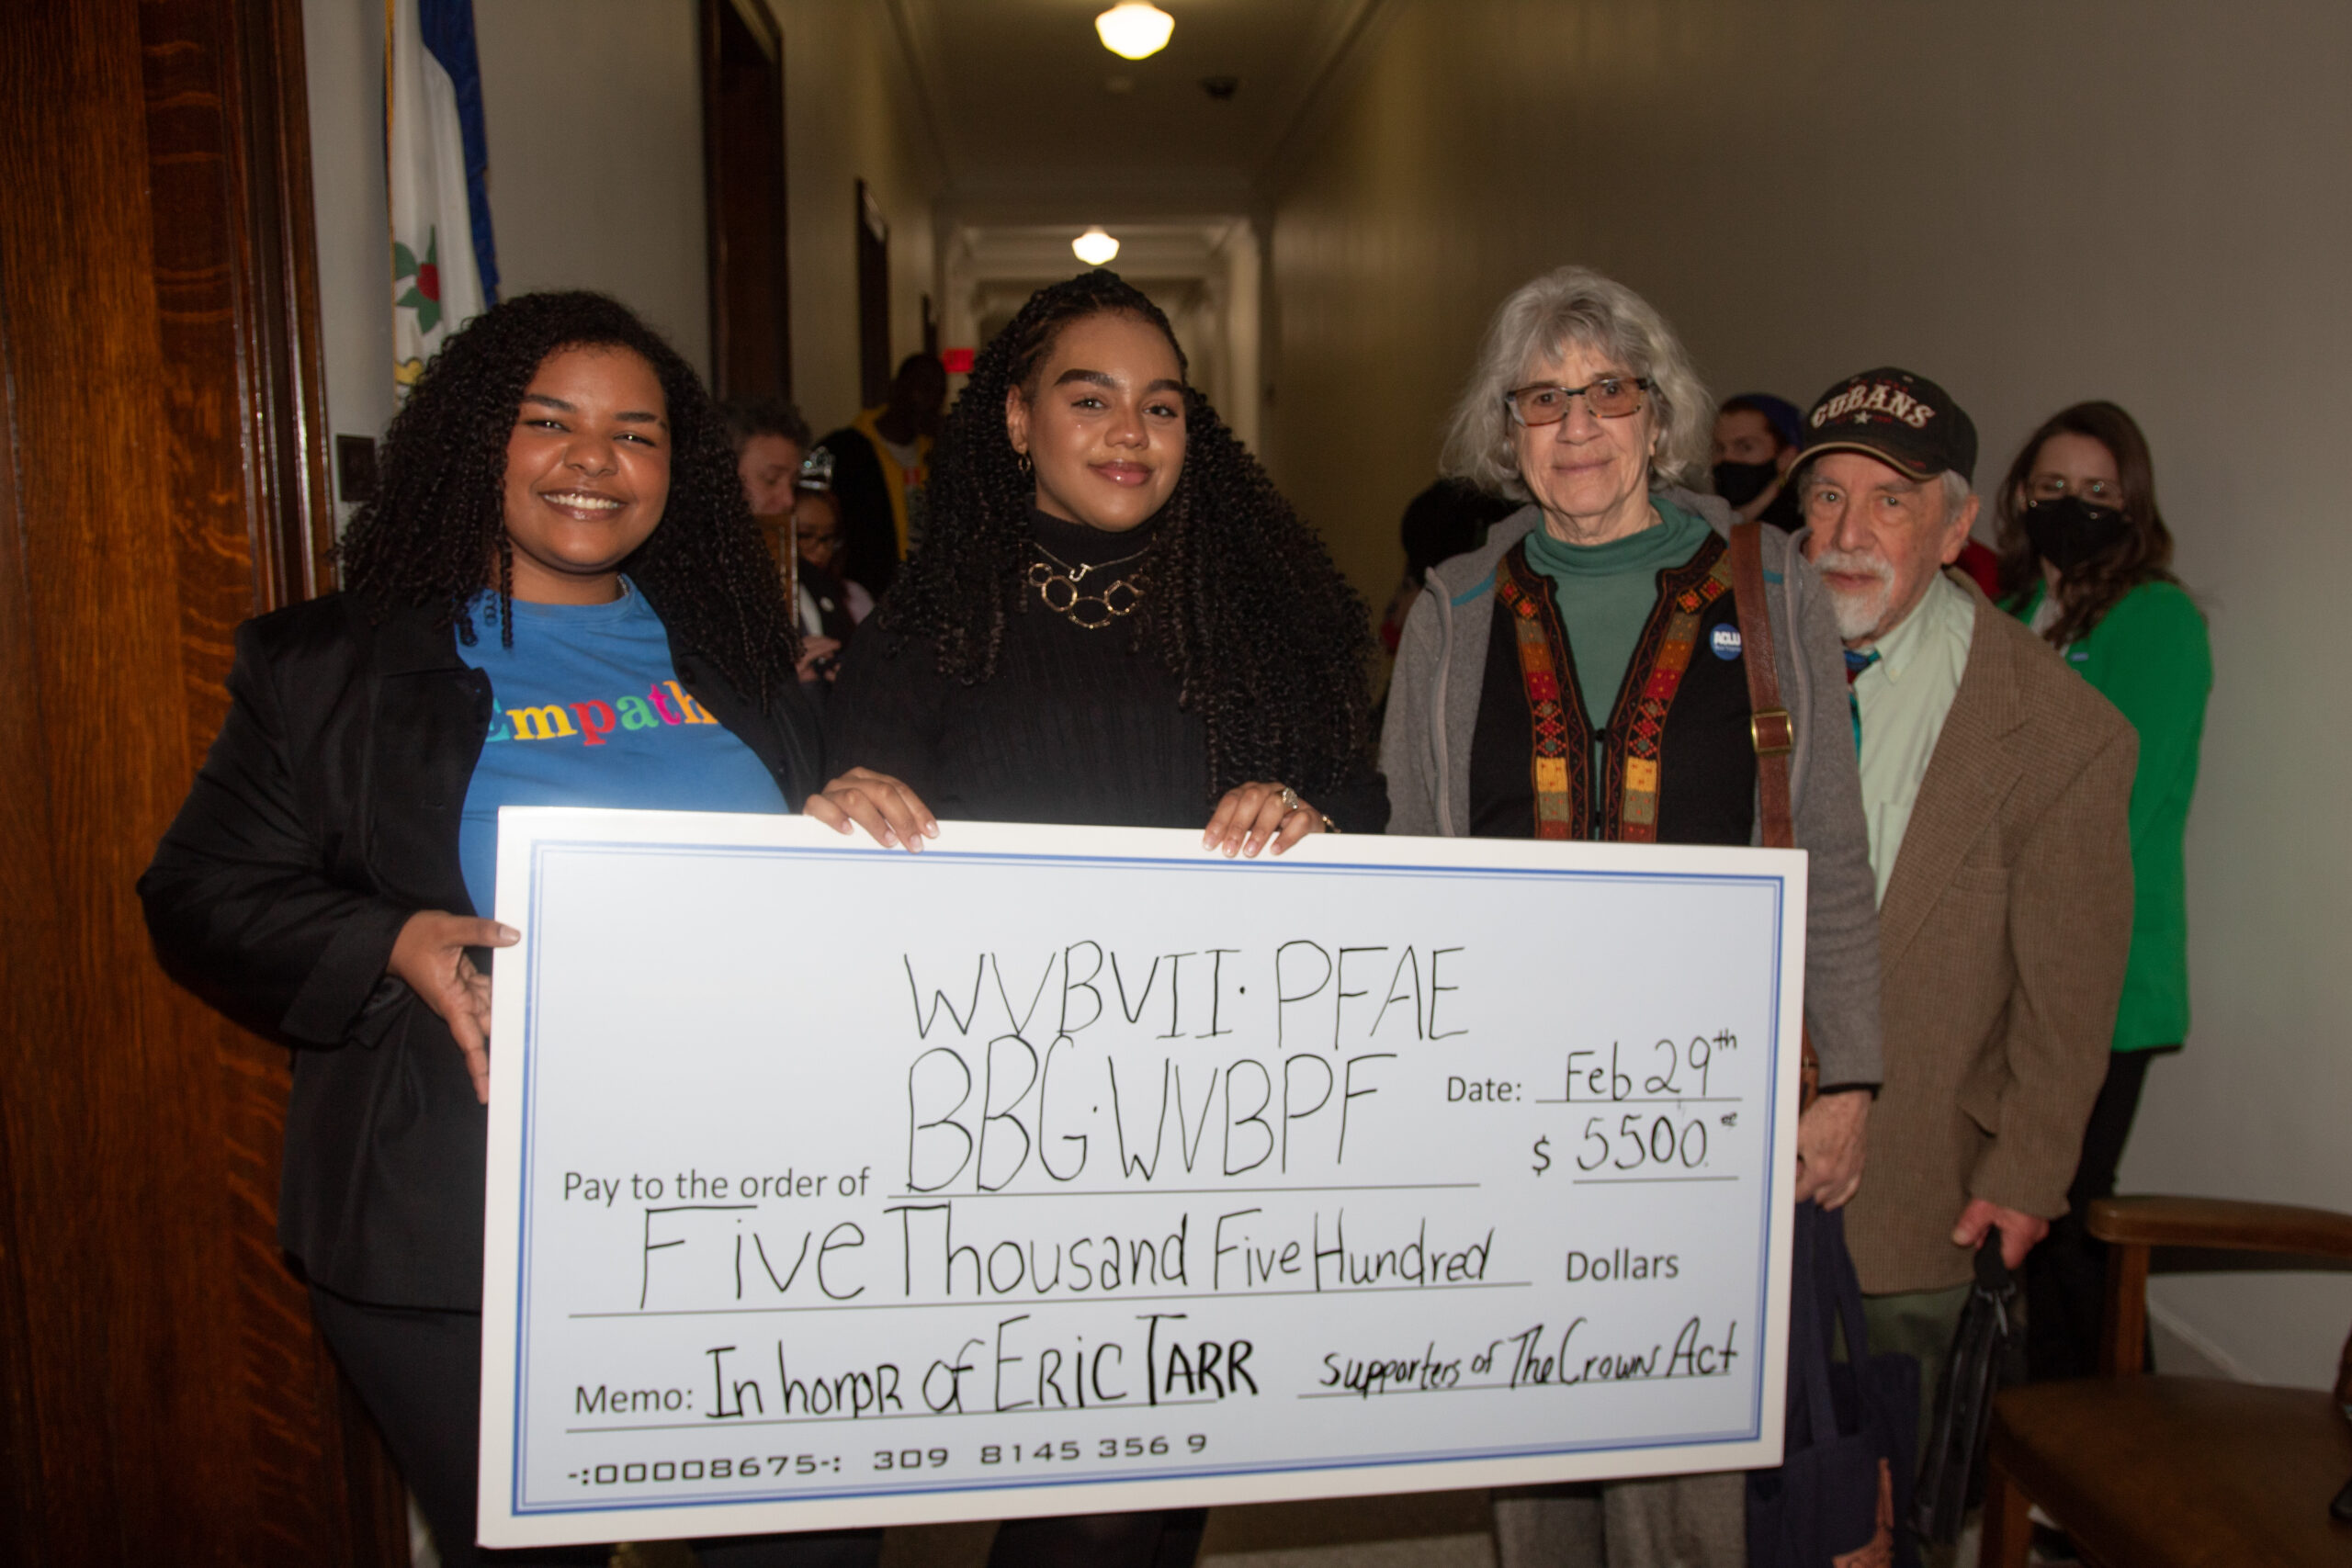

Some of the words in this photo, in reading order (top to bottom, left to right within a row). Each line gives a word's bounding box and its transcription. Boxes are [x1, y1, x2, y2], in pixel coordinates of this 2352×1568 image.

[1811, 384, 1937, 429] CUBANS
[1275, 939, 1469, 1051] PFAE
[1446, 1076, 1521, 1102] Date:
[1566, 1041, 1633, 1103] Feb
[1532, 1134, 1552, 1177] $
[565, 1171, 620, 1208] Pay
[631, 1173, 664, 1201] to
[675, 1168, 729, 1200] the
[740, 1168, 828, 1199] order
[838, 1167, 871, 1197] of
[640, 1203, 865, 1310] Five
[882, 1200, 1189, 1297] Thousand
[1214, 1208, 1303, 1292] Five
[1312, 1207, 1495, 1292] Hundred
[1566, 1247, 1679, 1283] Dollars
[705, 1345, 764, 1418] In
[922, 1338, 986, 1416] of
[1136, 1313, 1260, 1408] TARR
[1470, 1338, 1504, 1375] of
[1663, 1315, 1739, 1379] Act
[575, 1384, 693, 1415] Memo:
[873, 1449, 949, 1471] 309
[979, 1440, 1080, 1465] 8145
